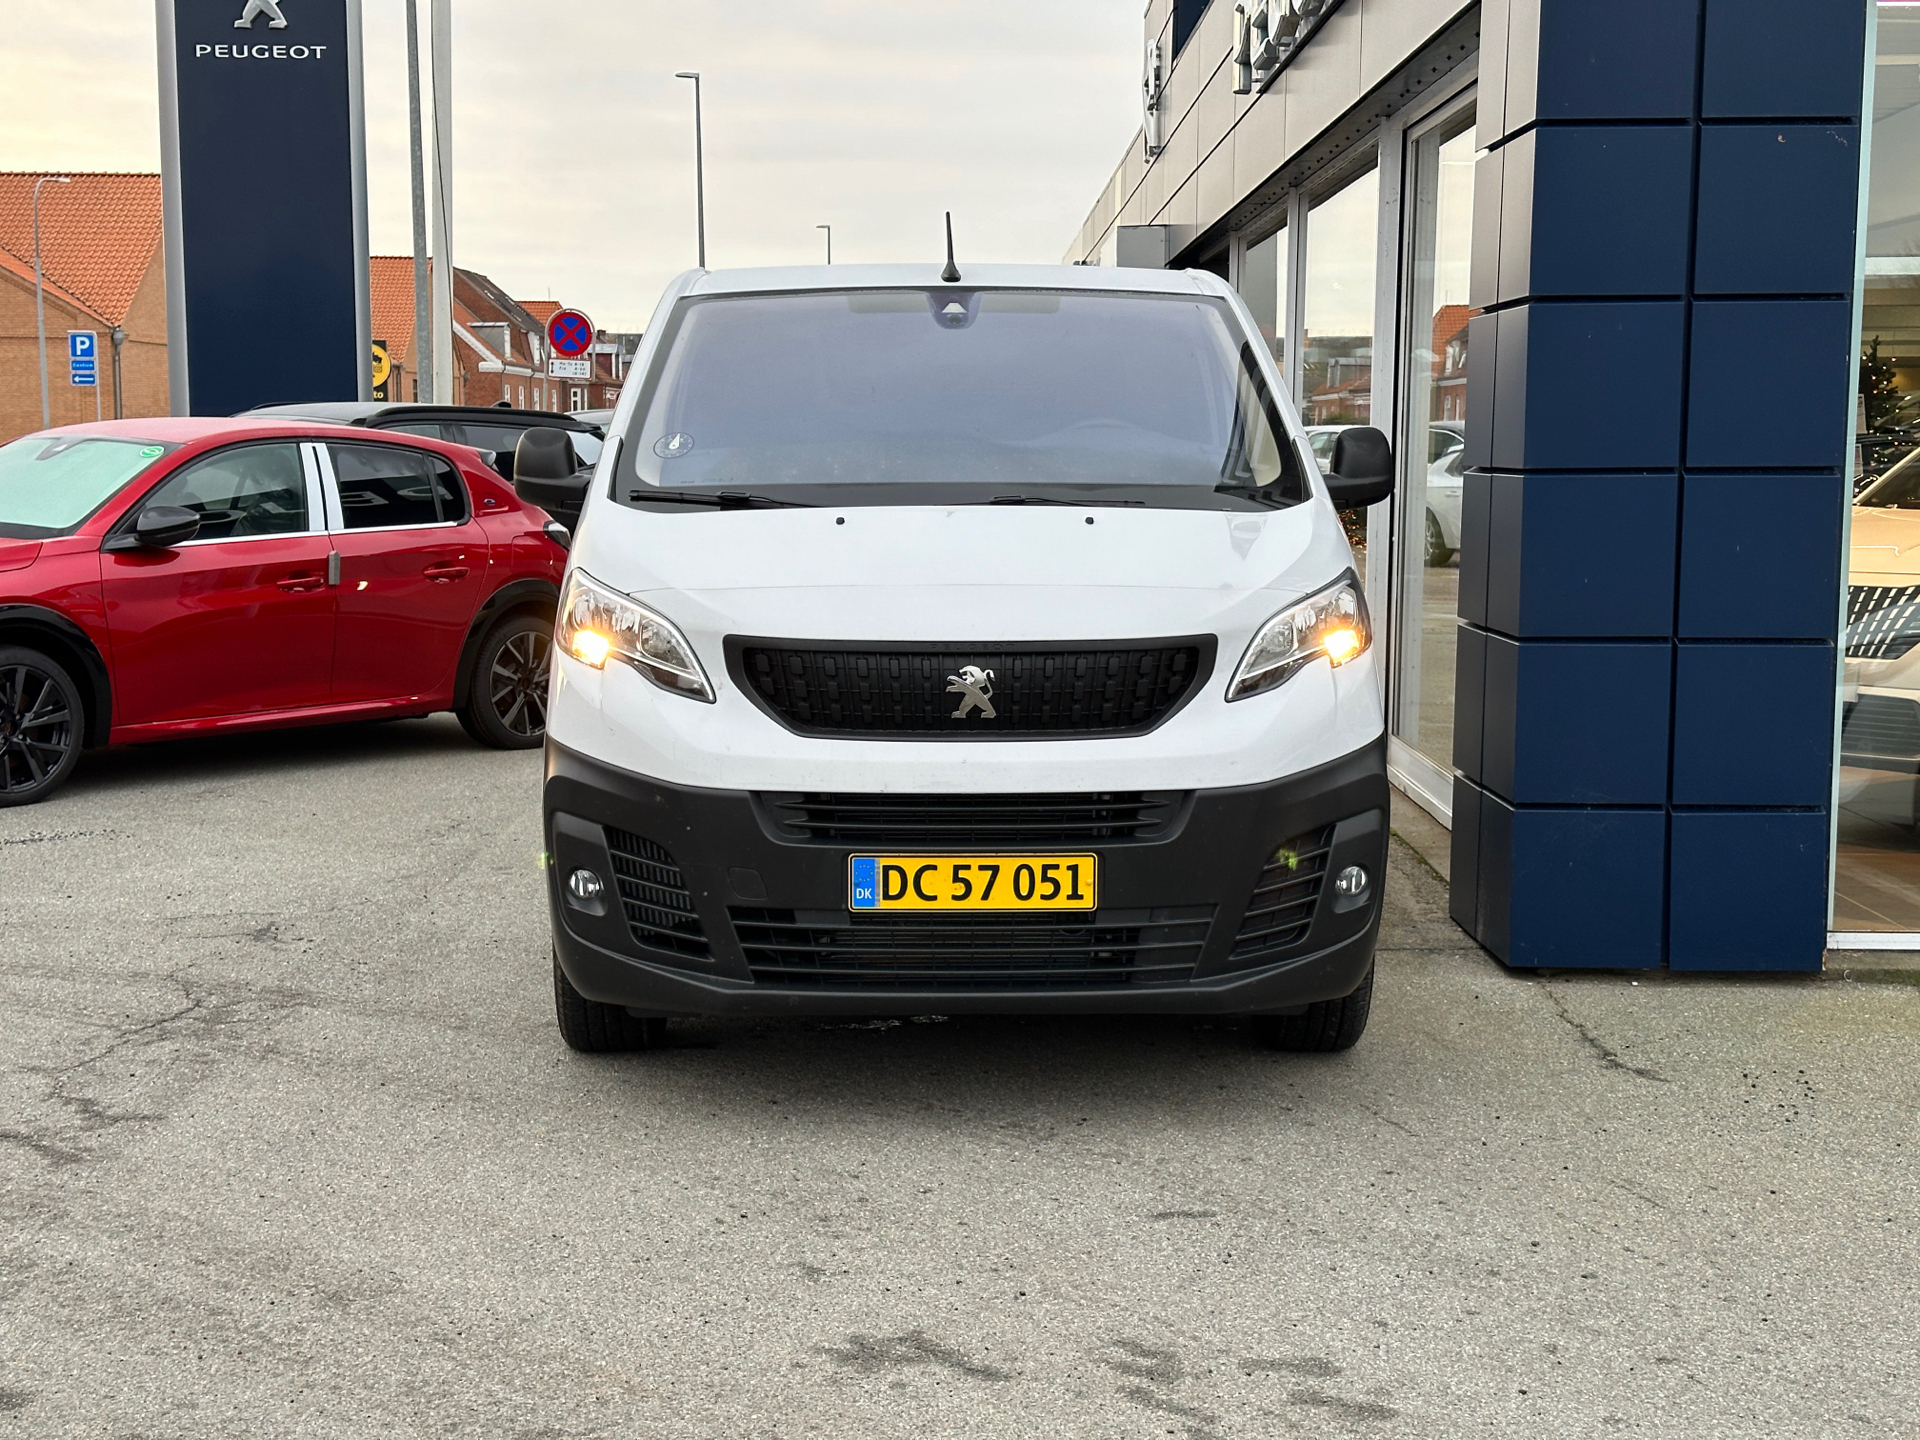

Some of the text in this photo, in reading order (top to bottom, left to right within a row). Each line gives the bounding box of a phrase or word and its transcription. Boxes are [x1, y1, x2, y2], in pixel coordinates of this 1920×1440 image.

[195, 43, 327, 59] PEUGEOT
[76, 336, 90, 356] P
[930, 643, 1015, 651] PEUGEOT
[856, 863, 1085, 901] DK DC 57 051
